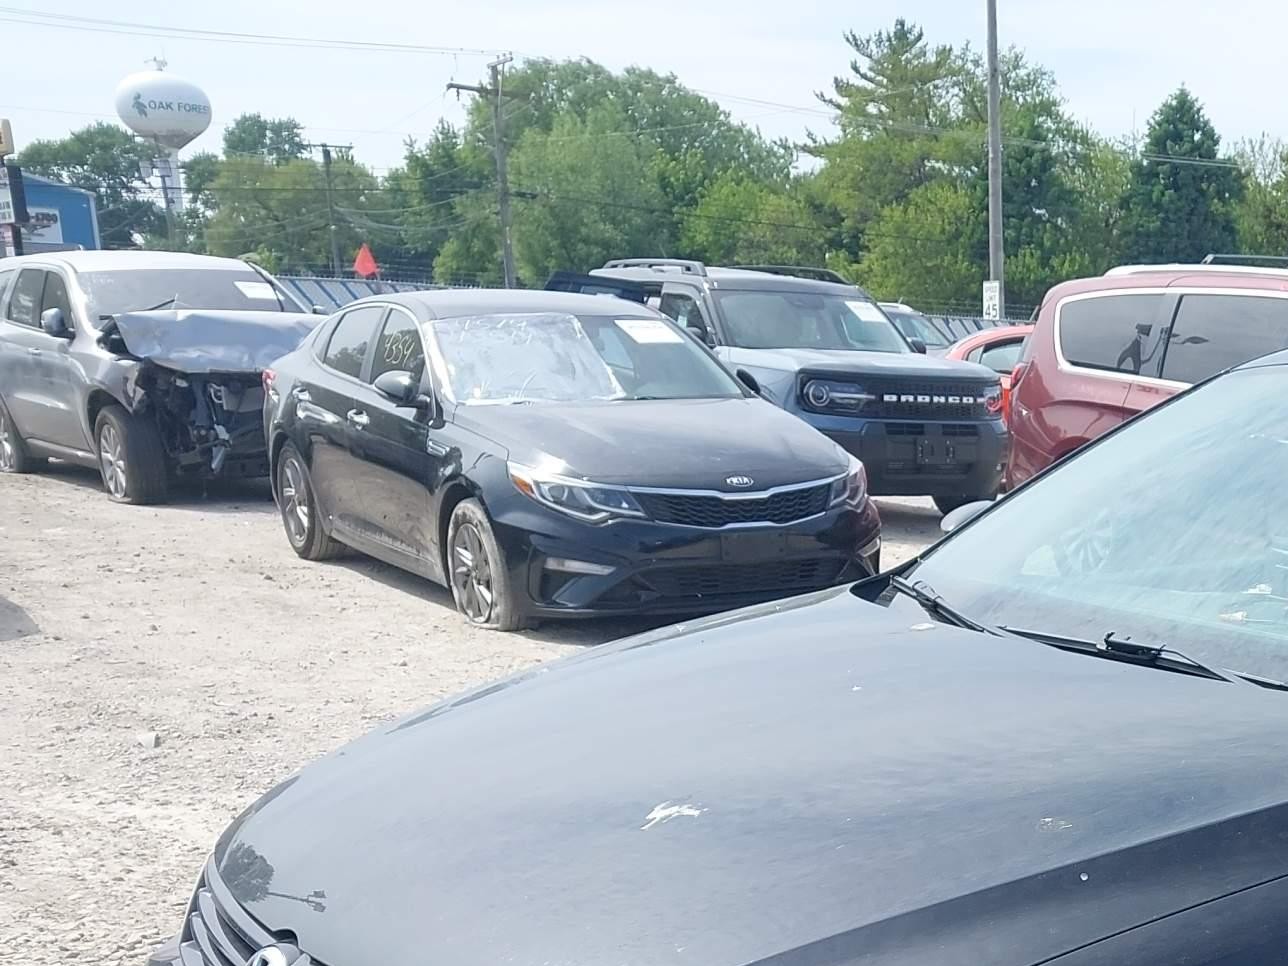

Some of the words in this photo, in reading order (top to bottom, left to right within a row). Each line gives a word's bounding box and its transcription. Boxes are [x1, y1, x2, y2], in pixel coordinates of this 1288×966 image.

[147, 100, 174, 111] OAK
[177, 102, 209, 114] FORES
[985, 303, 998, 318] 45
[883, 394, 974, 404] BRONCO
